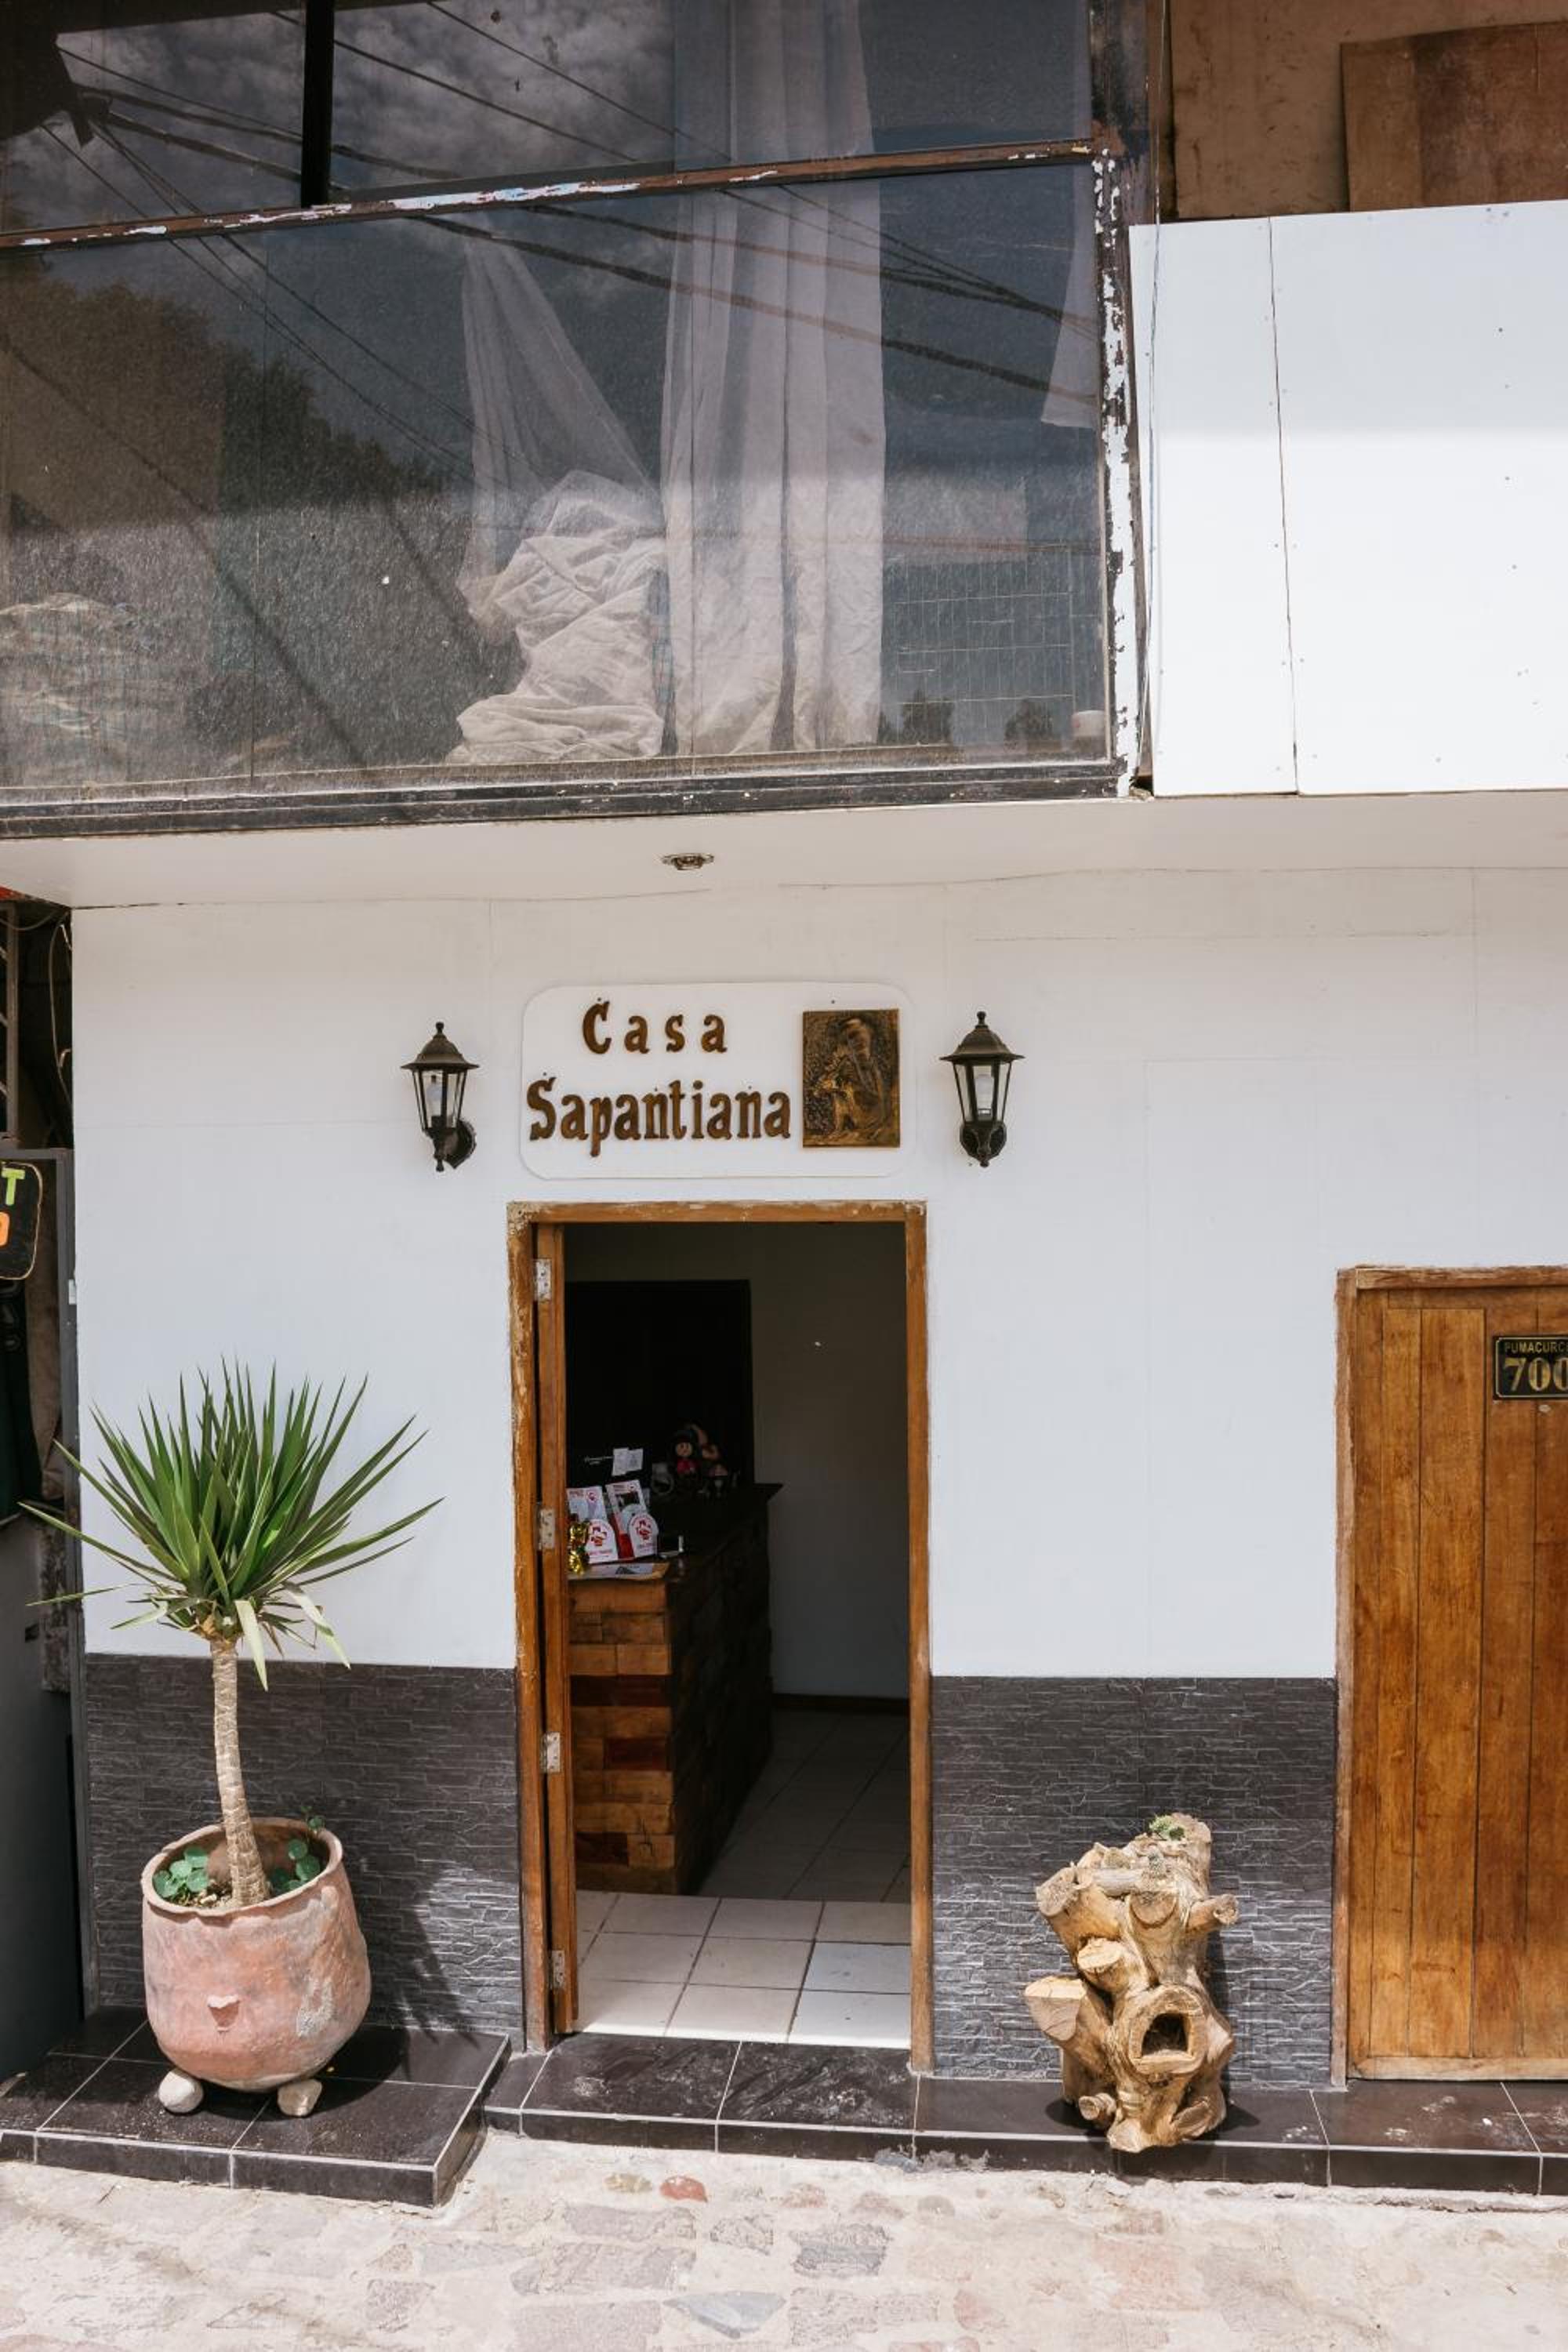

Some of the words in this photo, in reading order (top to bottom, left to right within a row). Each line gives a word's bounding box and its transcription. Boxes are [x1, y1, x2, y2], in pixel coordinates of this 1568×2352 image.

[582, 1001, 728, 1054] Casa
[526, 1076, 791, 1158] Sapantiana
[1504, 1341, 1568, 1355] PUMACURC
